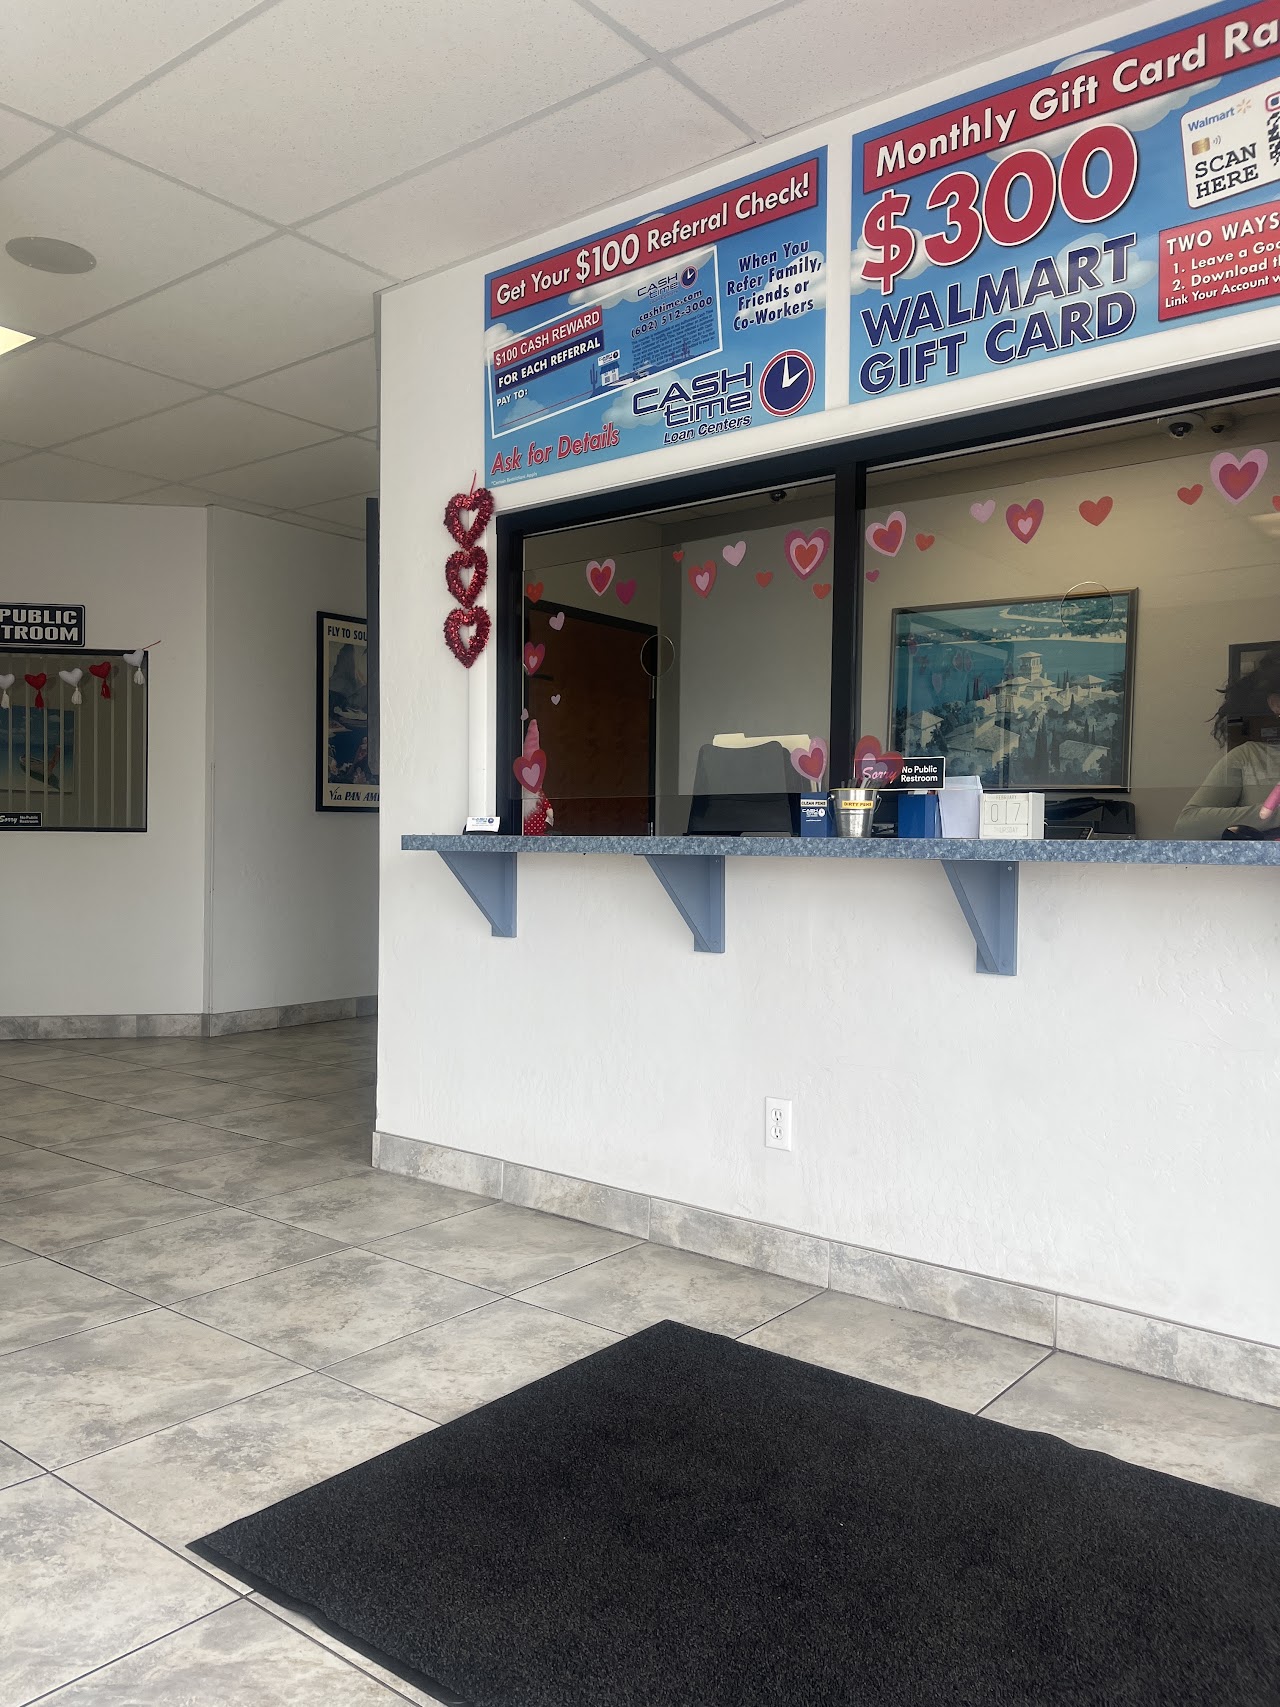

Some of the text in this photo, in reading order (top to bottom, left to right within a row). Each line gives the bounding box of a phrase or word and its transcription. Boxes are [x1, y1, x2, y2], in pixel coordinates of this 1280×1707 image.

[876, 18, 1278, 178] Monthly Gift Card Ra
[1188, 107, 1235, 131] Walmart
[1195, 142, 1257, 179] SCAN
[1196, 164, 1259, 199] HERE
[860, 123, 1139, 296] $300
[496, 172, 811, 305] Get Your $100 Referral Check!
[1166, 211, 1280, 255] TWO WAYS
[738, 240, 809, 273] When You
[1173, 262, 1186, 275] 1.
[1191, 252, 1234, 270] Leave
[1238, 248, 1248, 258] a
[637, 272, 678, 297] CASH
[649, 282, 678, 299] time
[726, 255, 822, 296] Refer Family,
[860, 232, 1137, 348] WALMART
[1165, 293, 1189, 308] Link
[1191, 288, 1218, 302] Your
[1220, 275, 1270, 295] Account
[1172, 279, 1186, 292] 2.
[1191, 258, 1268, 287] Download
[639, 289, 702, 322] cashtime.com
[738, 279, 810, 311] Friends or
[631, 320, 658, 339] (602)
[661, 296, 713, 325] 512-3000
[733, 298, 814, 331] Co-Workers
[495, 311, 600, 366] $100 CASH REWARD
[860, 290, 1137, 394] GIFT CARD
[498, 371, 519, 388] FOR
[521, 358, 548, 379] EACH
[550, 337, 601, 367] REFERRAL
[496, 388, 528, 408] PAY TO:
[632, 362, 753, 417] CASH
[663, 390, 752, 428] time
[663, 415, 752, 446] Loan Centers
[490, 421, 621, 475] Ask for Details
[0, 608, 77, 625] PUBLIC
[0, 624, 79, 641] TROOM
[327, 625, 340, 637] FLY
[341, 627, 351, 639] TO
[862, 766, 898, 785] Sorry
[900, 774, 938, 783] Restroom
[901, 764, 938, 774] No Public
[329, 786, 342, 801] Via
[344, 791, 362, 801] PAN
